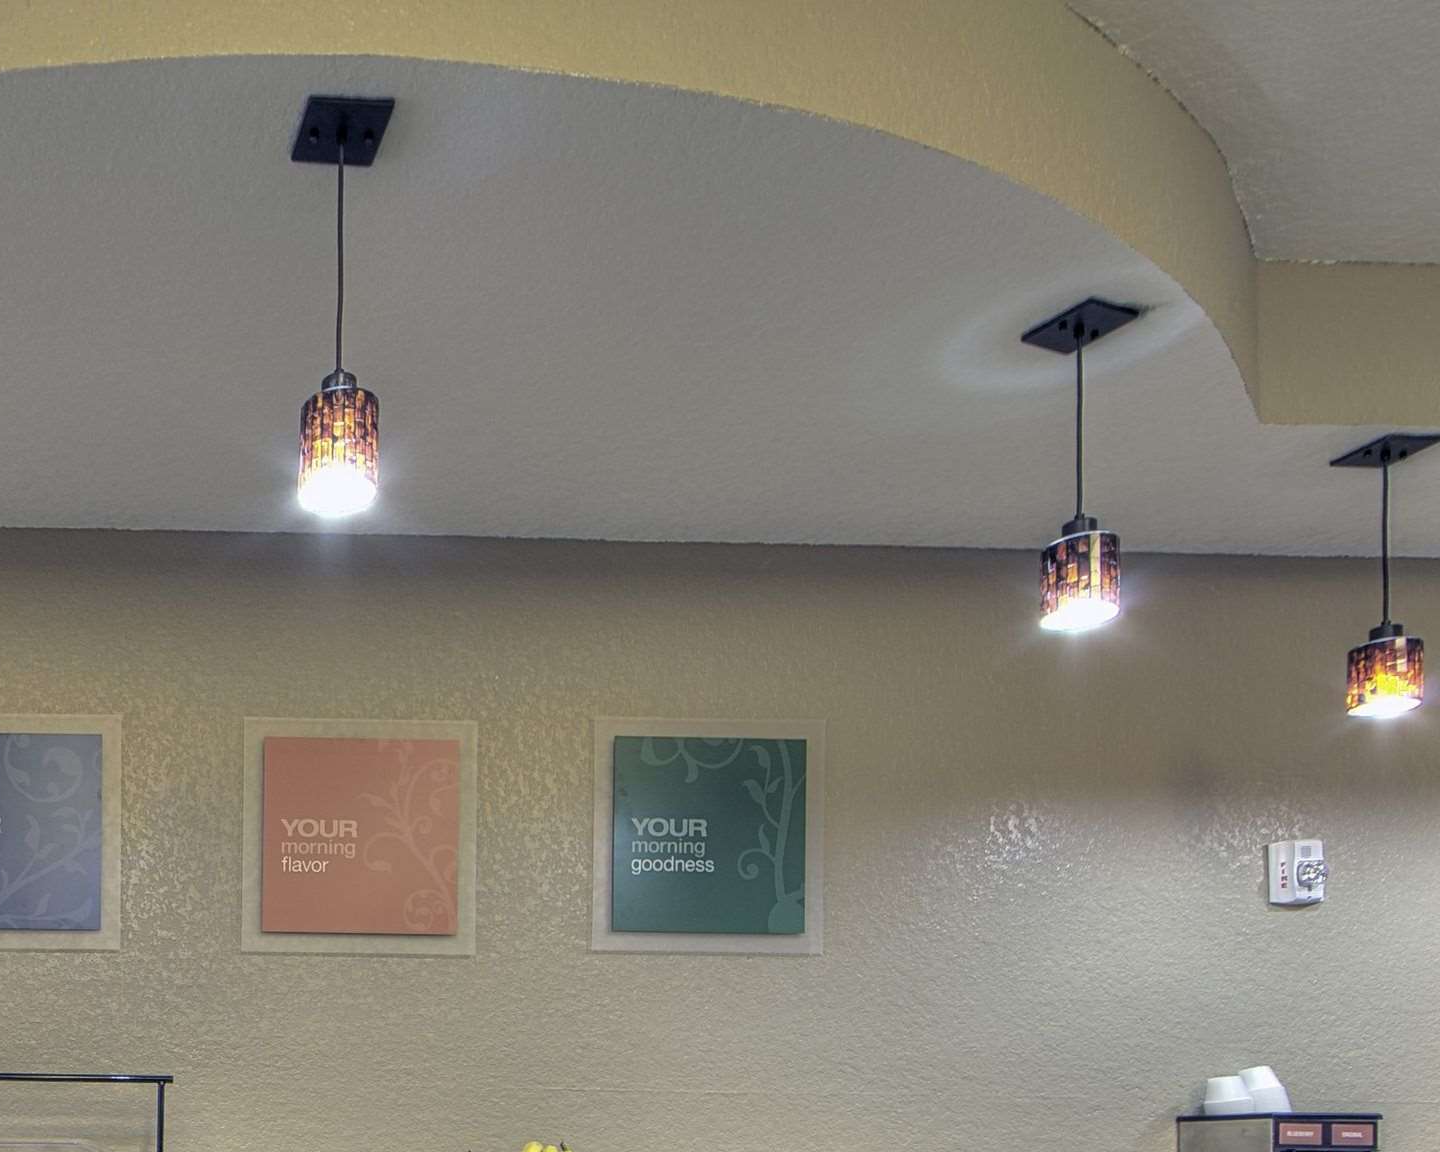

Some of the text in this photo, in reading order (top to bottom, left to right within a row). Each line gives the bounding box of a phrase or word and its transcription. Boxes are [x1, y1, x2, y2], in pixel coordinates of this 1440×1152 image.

[281, 818, 358, 837] YOUR
[631, 818, 708, 837] YOUR
[281, 840, 356, 859] morning
[631, 839, 706, 858] morning
[281, 856, 329, 872] flavor
[631, 856, 715, 875] goodness
